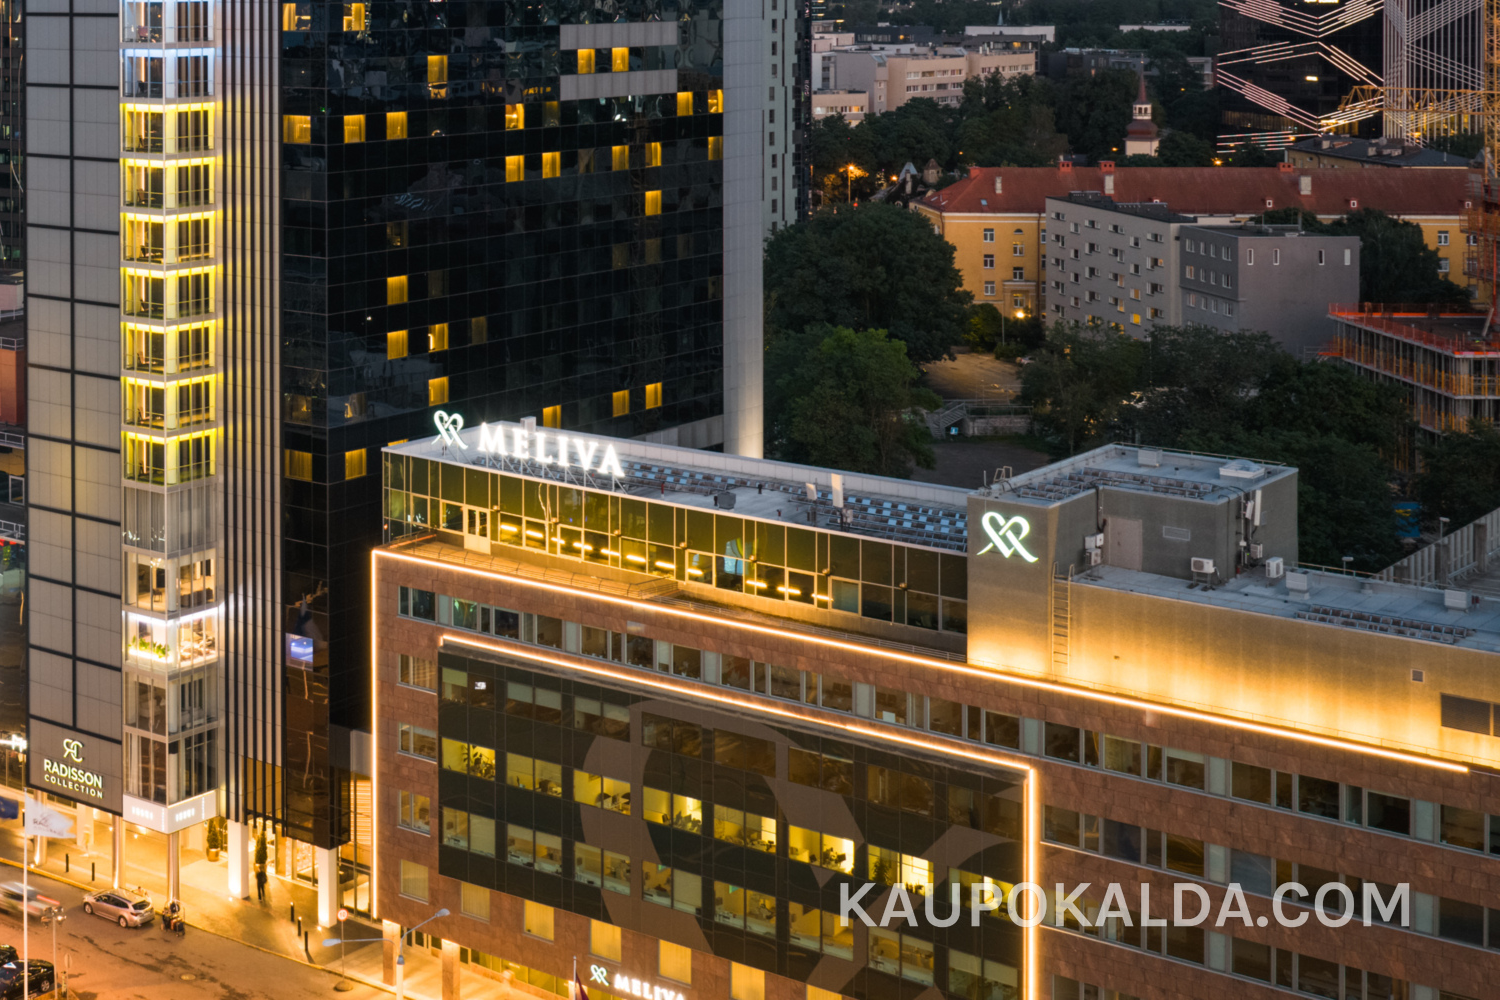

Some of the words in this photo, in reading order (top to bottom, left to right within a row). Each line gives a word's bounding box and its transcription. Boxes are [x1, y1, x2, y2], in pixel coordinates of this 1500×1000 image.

[478, 422, 626, 478] MELIVA
[43, 758, 103, 788] RADISSON
[44, 774, 103, 799] COLLECTION
